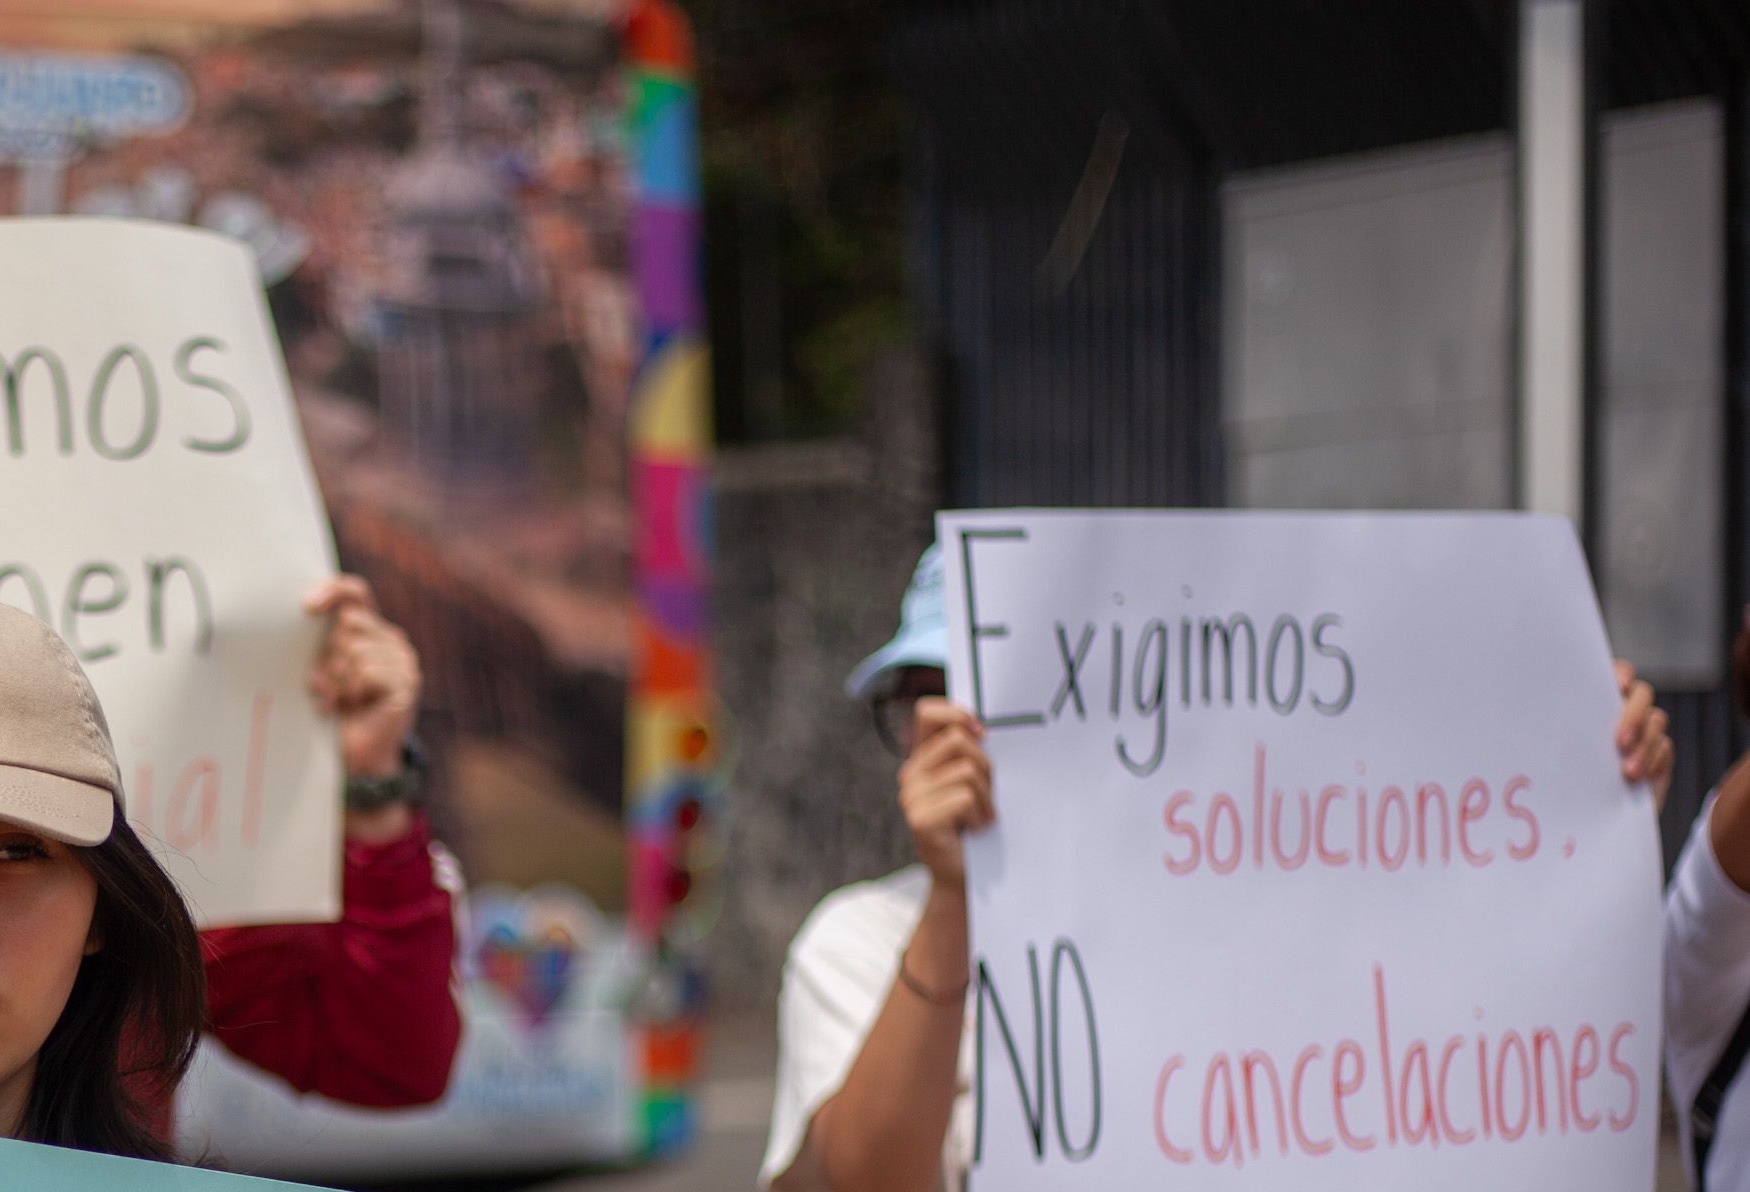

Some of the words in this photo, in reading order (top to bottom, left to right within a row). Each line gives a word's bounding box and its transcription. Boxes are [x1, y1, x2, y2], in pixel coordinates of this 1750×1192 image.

[959, 528, 1355, 776] Exigimos
[972, 937, 1104, 1167] NO
[1153, 963, 1641, 1168] cancelaciones
